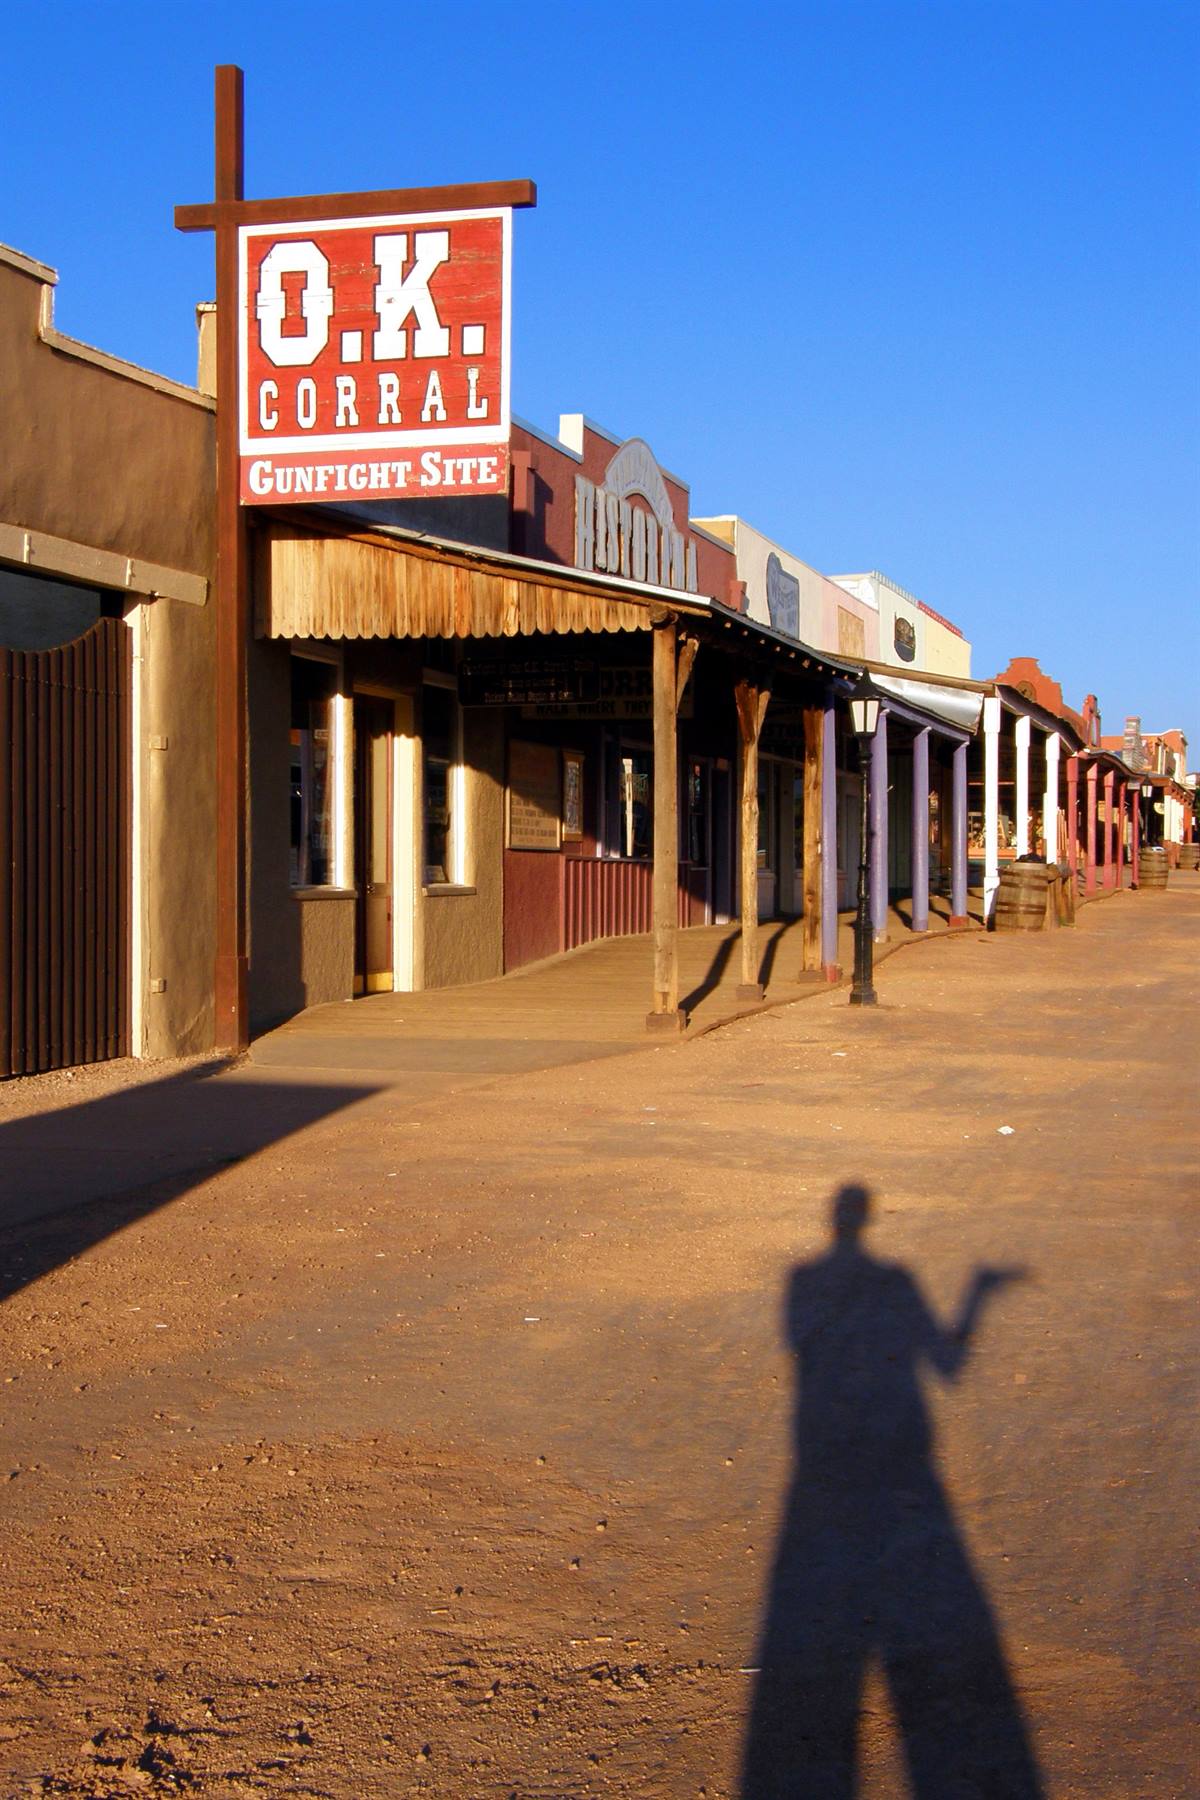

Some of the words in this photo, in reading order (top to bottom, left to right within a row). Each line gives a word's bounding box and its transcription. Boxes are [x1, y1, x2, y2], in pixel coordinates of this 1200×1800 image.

[256, 230, 486, 367] O.K.
[259, 367, 488, 431] CORRAL
[249, 460, 412, 495] GUNFIGHT
[419, 451, 498, 487] SITE
